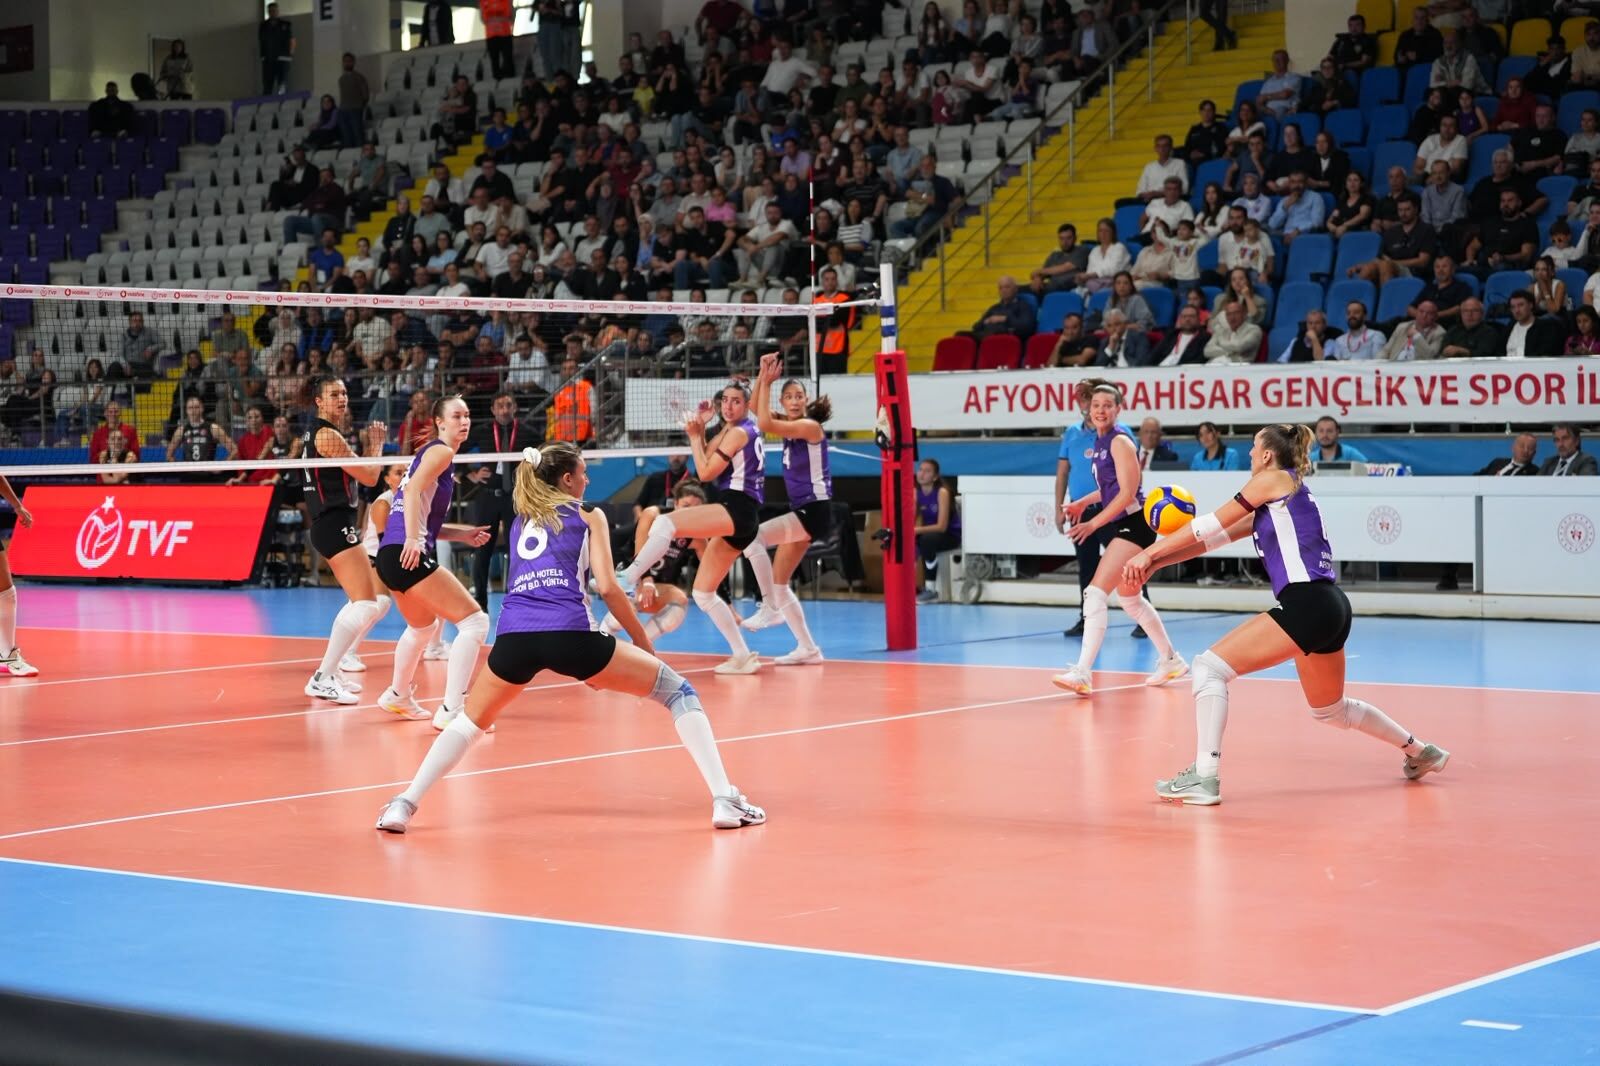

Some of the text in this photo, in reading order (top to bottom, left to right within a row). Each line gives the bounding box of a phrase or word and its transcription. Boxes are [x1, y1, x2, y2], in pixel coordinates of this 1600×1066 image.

[320, 0, 334, 20] E
[1259, 369, 1408, 416] GENÇLİK
[1414, 374, 1459, 406] VE
[1469, 373, 1566, 406] SPOR
[127, 519, 194, 557] TVF
[517, 519, 547, 560] 6
[536, 568, 564, 579] HOTELS
